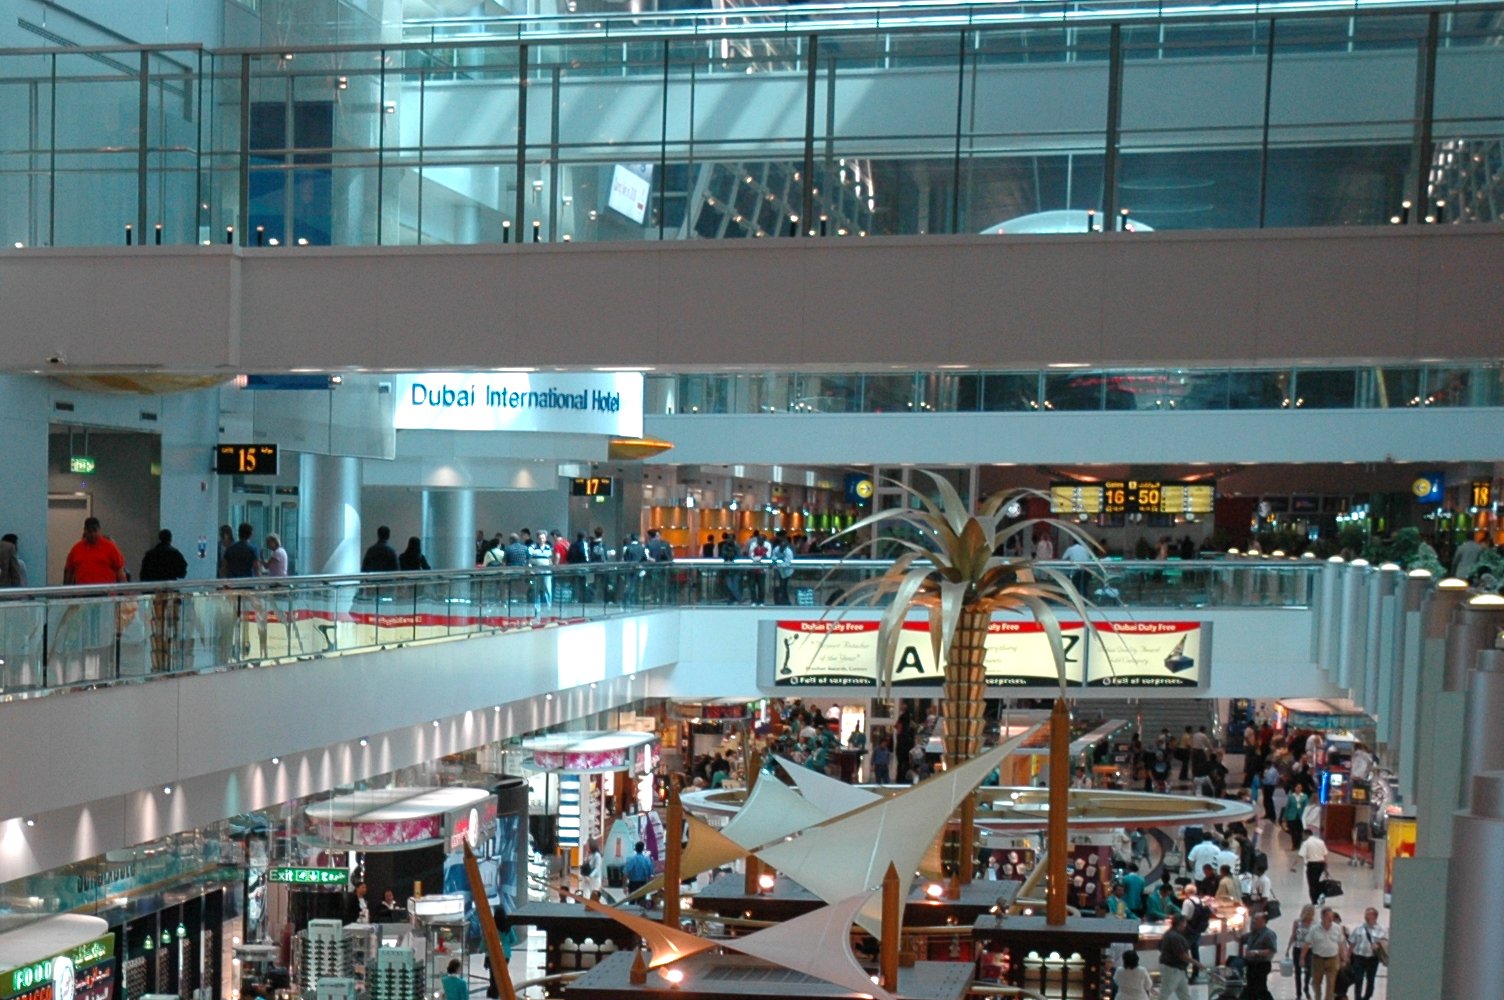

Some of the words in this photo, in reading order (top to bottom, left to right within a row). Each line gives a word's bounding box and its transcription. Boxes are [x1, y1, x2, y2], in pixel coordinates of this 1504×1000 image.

[412, 383, 476, 407] Dubai
[485, 384, 588, 410] International
[591, 389, 620, 412] Hotel
[238, 447, 256, 473] 15
[586, 478, 599, 495] 17
[1106, 490, 1125, 505] 16
[1138, 490, 1159, 505] 50
[1473, 487, 1489, 507] 18
[845, 622, 864, 631] Free
[1001, 623, 1020, 631] Free
[1113, 623, 1137, 632] Dubai
[1138, 623, 1157, 633] Duty
[1158, 624, 1176, 632] Free
[1061, 635, 1080, 662] Z
[895, 646, 925, 673] A
[269, 869, 294, 882] Exit
[13, 960, 52, 991] FOOD
